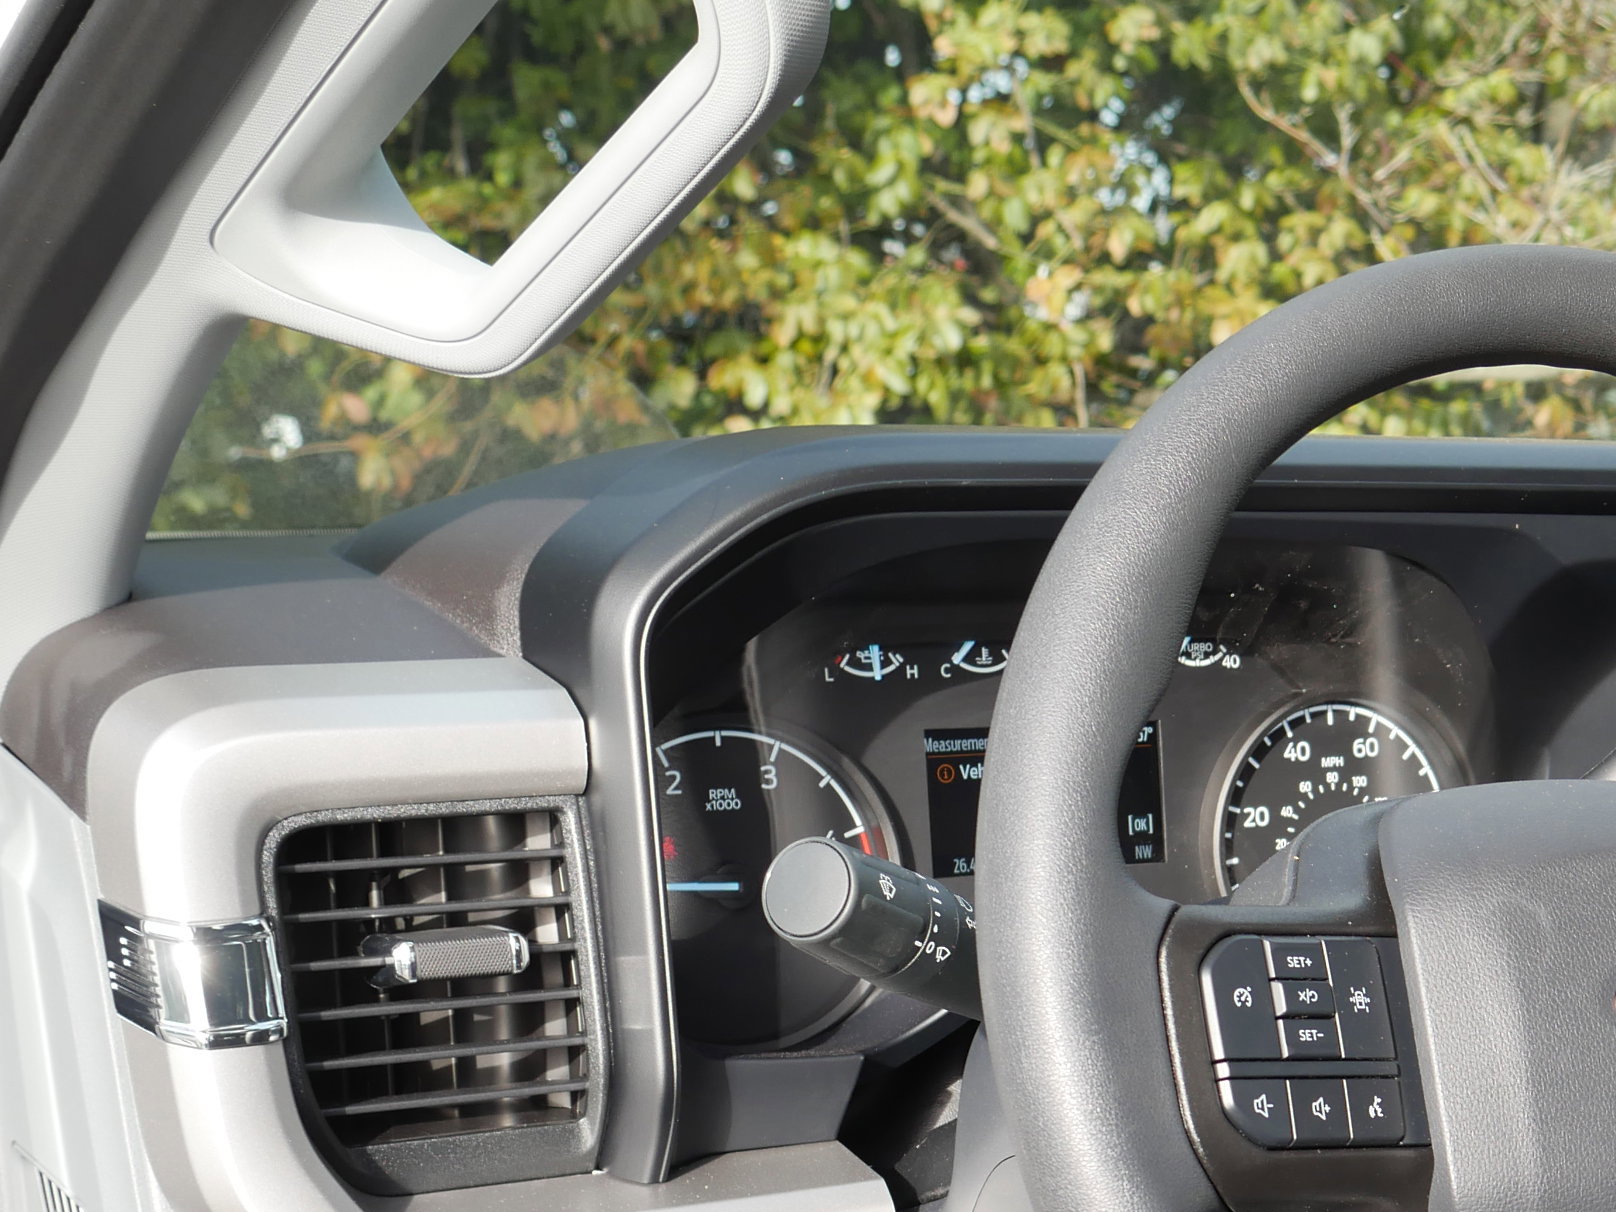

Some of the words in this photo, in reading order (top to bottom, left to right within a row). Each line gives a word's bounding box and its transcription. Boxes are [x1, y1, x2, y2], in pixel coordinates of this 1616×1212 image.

[1222, 654, 1240, 669] 40
[824, 667, 835, 682] L
[906, 664, 919, 679] H
[940, 663, 952, 678] C
[1283, 740, 1311, 762] 40
[1352, 737, 1379, 758] 60
[1321, 756, 1344, 768] MPH
[665, 770, 683, 795] 2
[760, 765, 778, 790] 3
[1326, 772, 1339, 783] 80
[1352, 776, 1367, 788] 100
[709, 788, 736, 800] RPM
[1299, 781, 1312, 794] 60
[705, 799, 741, 811] x1000
[1280, 805, 1293, 818] 40
[1243, 806, 1270, 828] 20
[1135, 844, 1152, 859] NW
[1286, 956, 1313, 968] SET+
